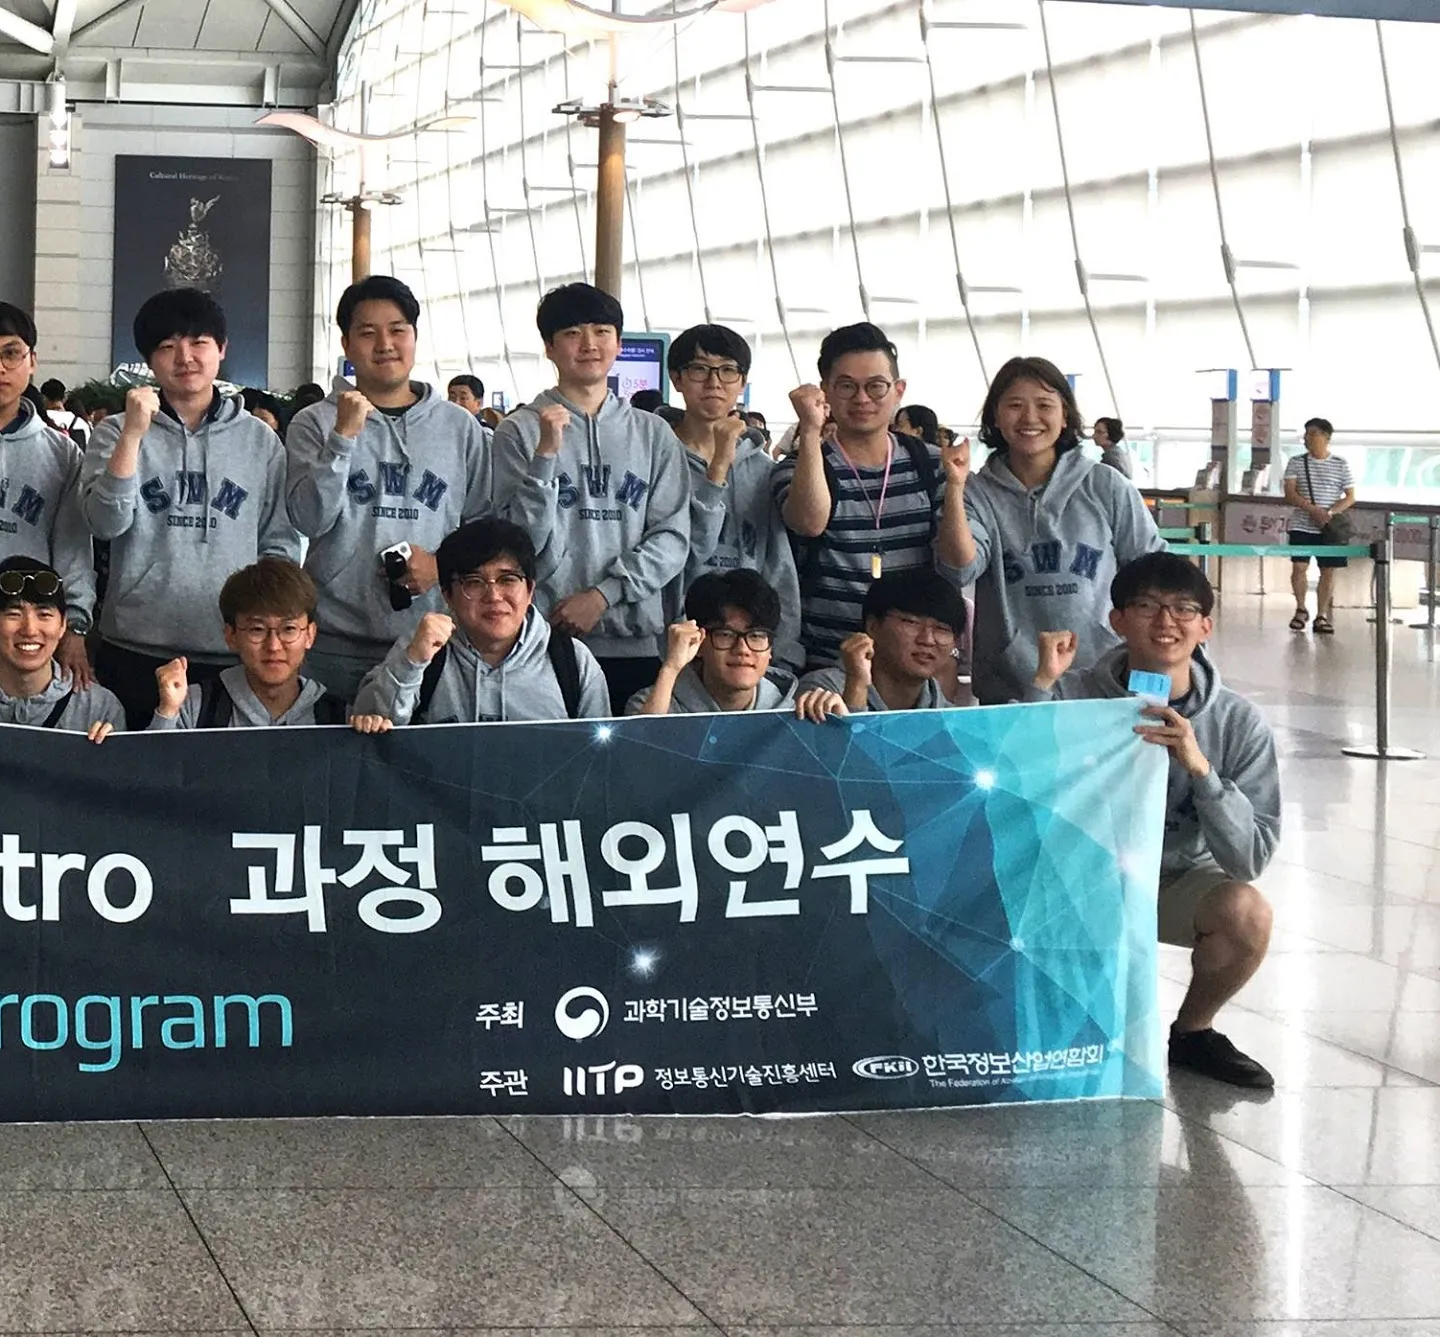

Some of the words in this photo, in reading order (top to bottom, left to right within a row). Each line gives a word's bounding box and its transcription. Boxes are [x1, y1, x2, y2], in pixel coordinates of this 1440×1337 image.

[372, 506, 397, 519] SINCE
[398, 507, 419, 520] 2010
[579, 508, 601, 520] SINCE
[601, 508, 623, 520] 2010
[166, 515, 194, 528] SINCE
[1055, 582, 1079, 596] 2010
[230, 823, 443, 934] 과정
[480, 808, 910, 928] 해외연수
[475, 1001, 525, 1030] 주최
[623, 993, 819, 1023] 과학기술정보통신부
[479, 1069, 529, 1097] 주관
[563, 1060, 645, 1096] IITP
[654, 1061, 838, 1091] 정보통신기술진흥센터
[921, 1044, 1105, 1077] 한국정보산업연합회
[928, 1079, 947, 1088] The
[947, 1078, 991, 1088] Federation
